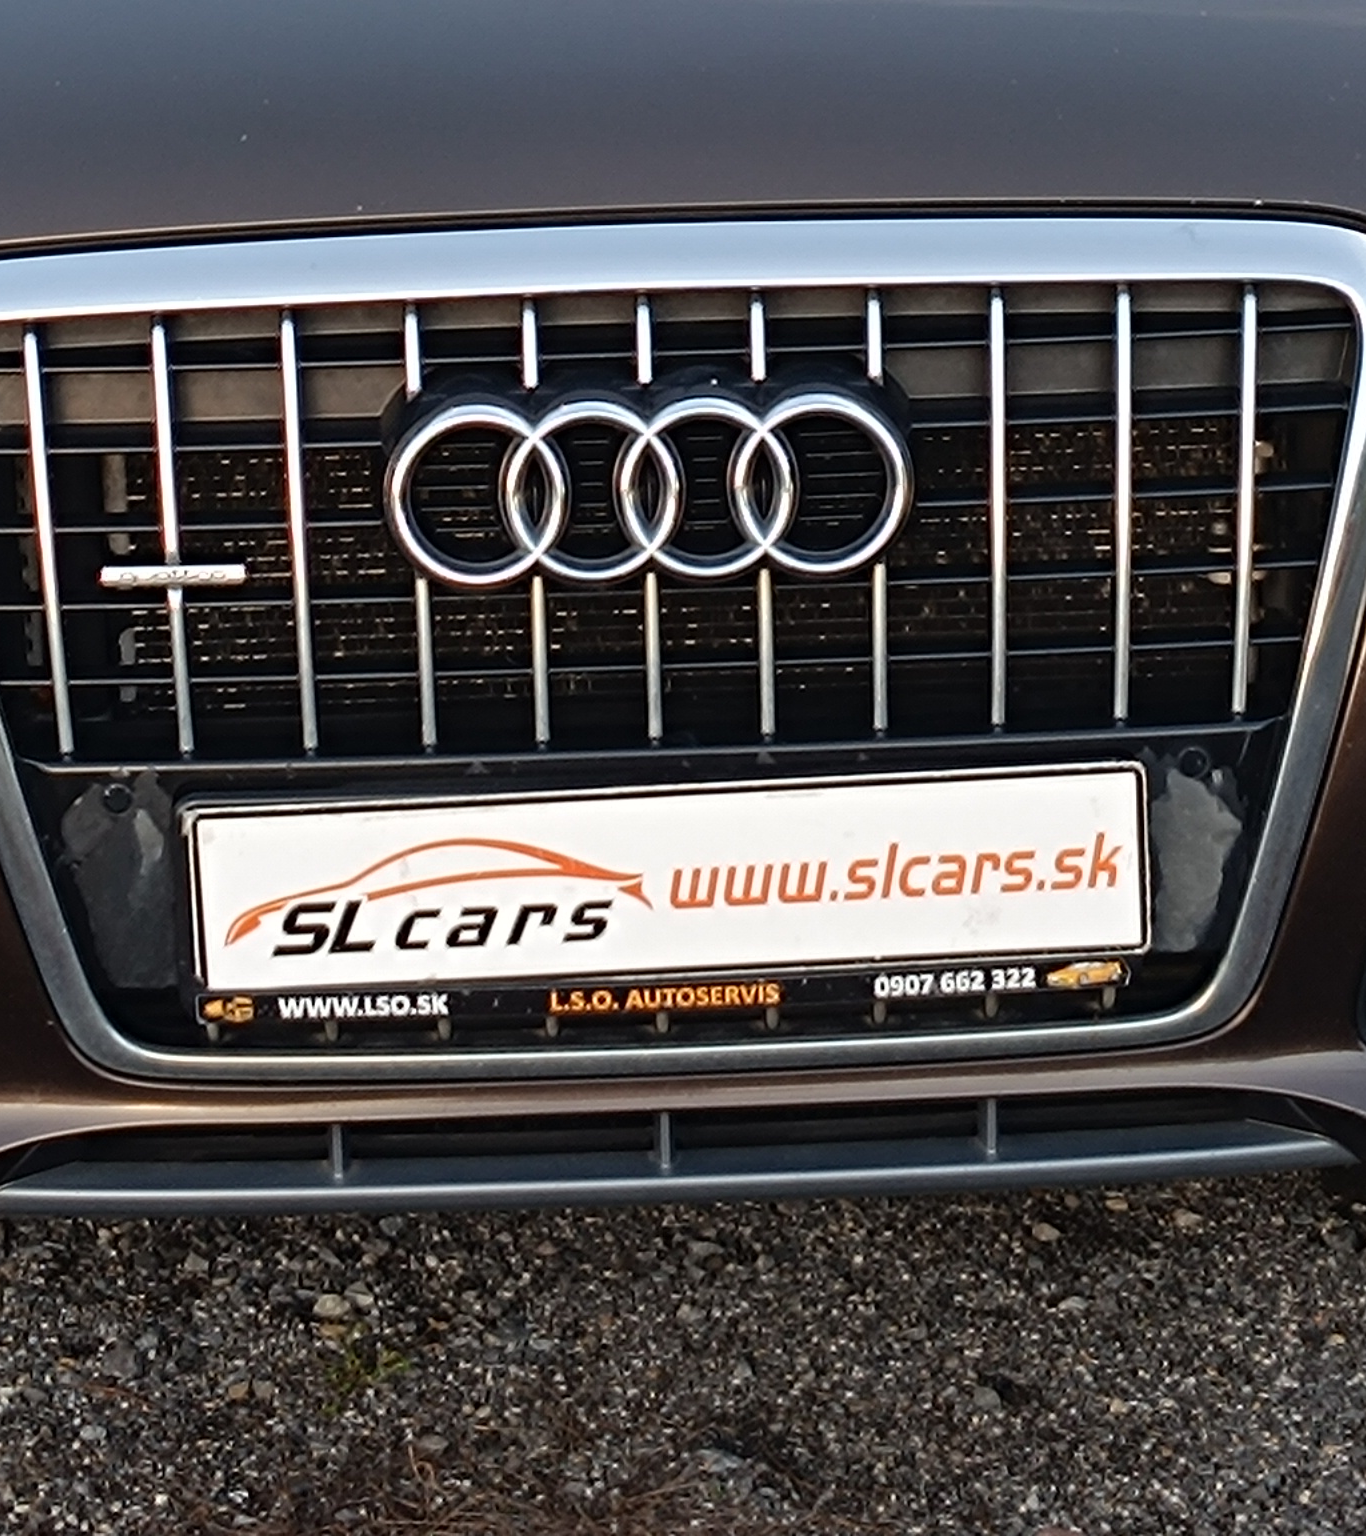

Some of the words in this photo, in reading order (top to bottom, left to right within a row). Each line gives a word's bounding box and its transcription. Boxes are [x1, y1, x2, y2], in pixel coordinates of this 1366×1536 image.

[669, 832, 1122, 909] www.slcars.sk
[550, 989, 620, 1012] L.S.O.
[626, 982, 781, 1009] AUTOSERVIS
[874, 973, 934, 998] 0907
[941, 971, 985, 992] 662
[991, 967, 1036, 989] 322
[278, 994, 450, 1019] WWW.LSO.SK
